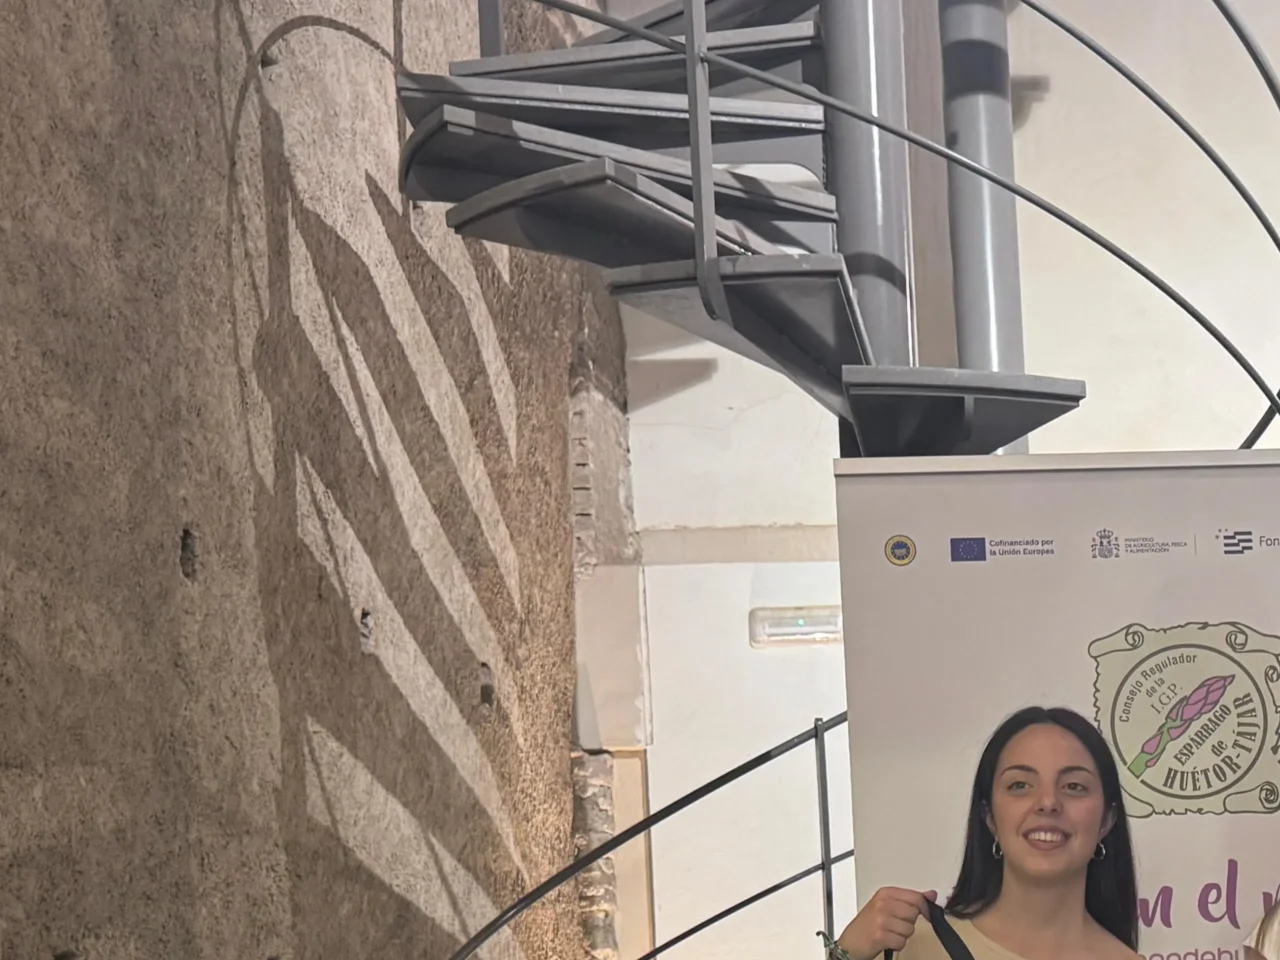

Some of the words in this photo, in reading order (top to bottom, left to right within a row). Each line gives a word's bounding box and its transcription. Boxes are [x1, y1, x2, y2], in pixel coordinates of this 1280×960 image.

[989, 539, 1038, 548] Cofinanciado
[1039, 539, 1054, 549] por
[989, 548, 998, 556] la
[998, 547, 1021, 556] Unión
[1022, 547, 1055, 557] Europea
[1119, 679, 1143, 723] Consejo
[1140, 653, 1198, 680] Regulador
[1145, 685, 1158, 698] de
[1158, 676, 1166, 687] la
[1210, 739, 1228, 757] de
[1197, 858, 1241, 930] el
